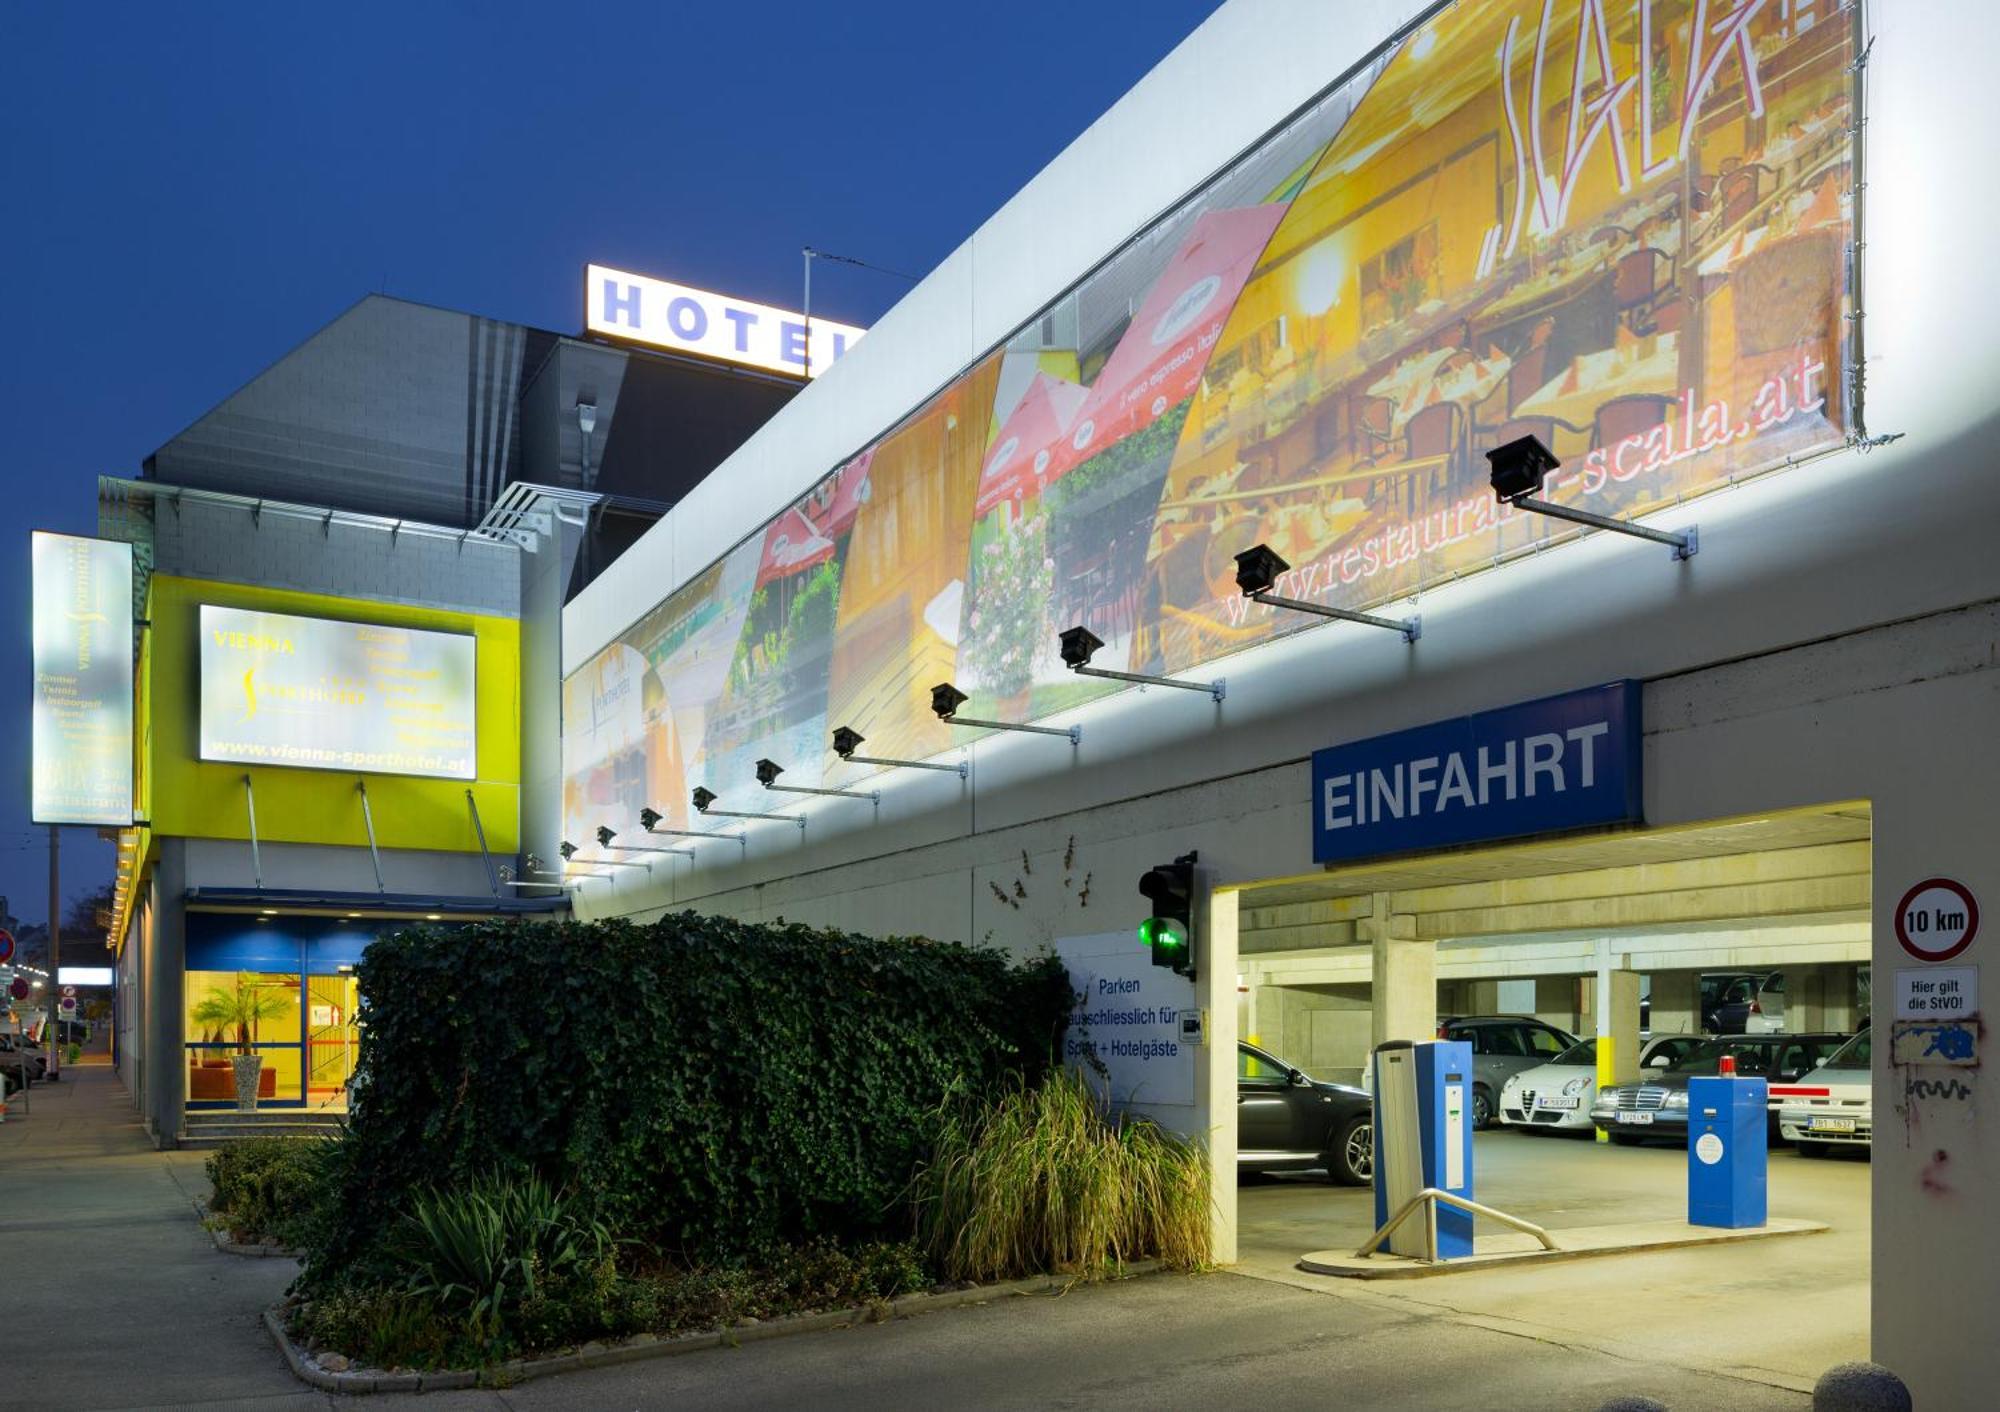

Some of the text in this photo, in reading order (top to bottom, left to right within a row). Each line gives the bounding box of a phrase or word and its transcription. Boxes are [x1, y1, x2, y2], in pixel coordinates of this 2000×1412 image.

[1223, 354, 1826, 626] ww.restaurat-scala.at
[214, 629, 296, 657] VIENNA
[210, 740, 467, 772] www.vienna-sporthotel.at
[1324, 721, 1609, 830] EINFAHRT
[1907, 909, 1964, 933] 10 km
[1100, 978, 1140, 995] Parken
[1911, 981, 1959, 995] Hier gilt
[1908, 996, 1963, 1010] die StVO!
[1069, 1006, 1178, 1026] ausschliesslich für
[1111, 1039, 1178, 1060] Hotelgäste
